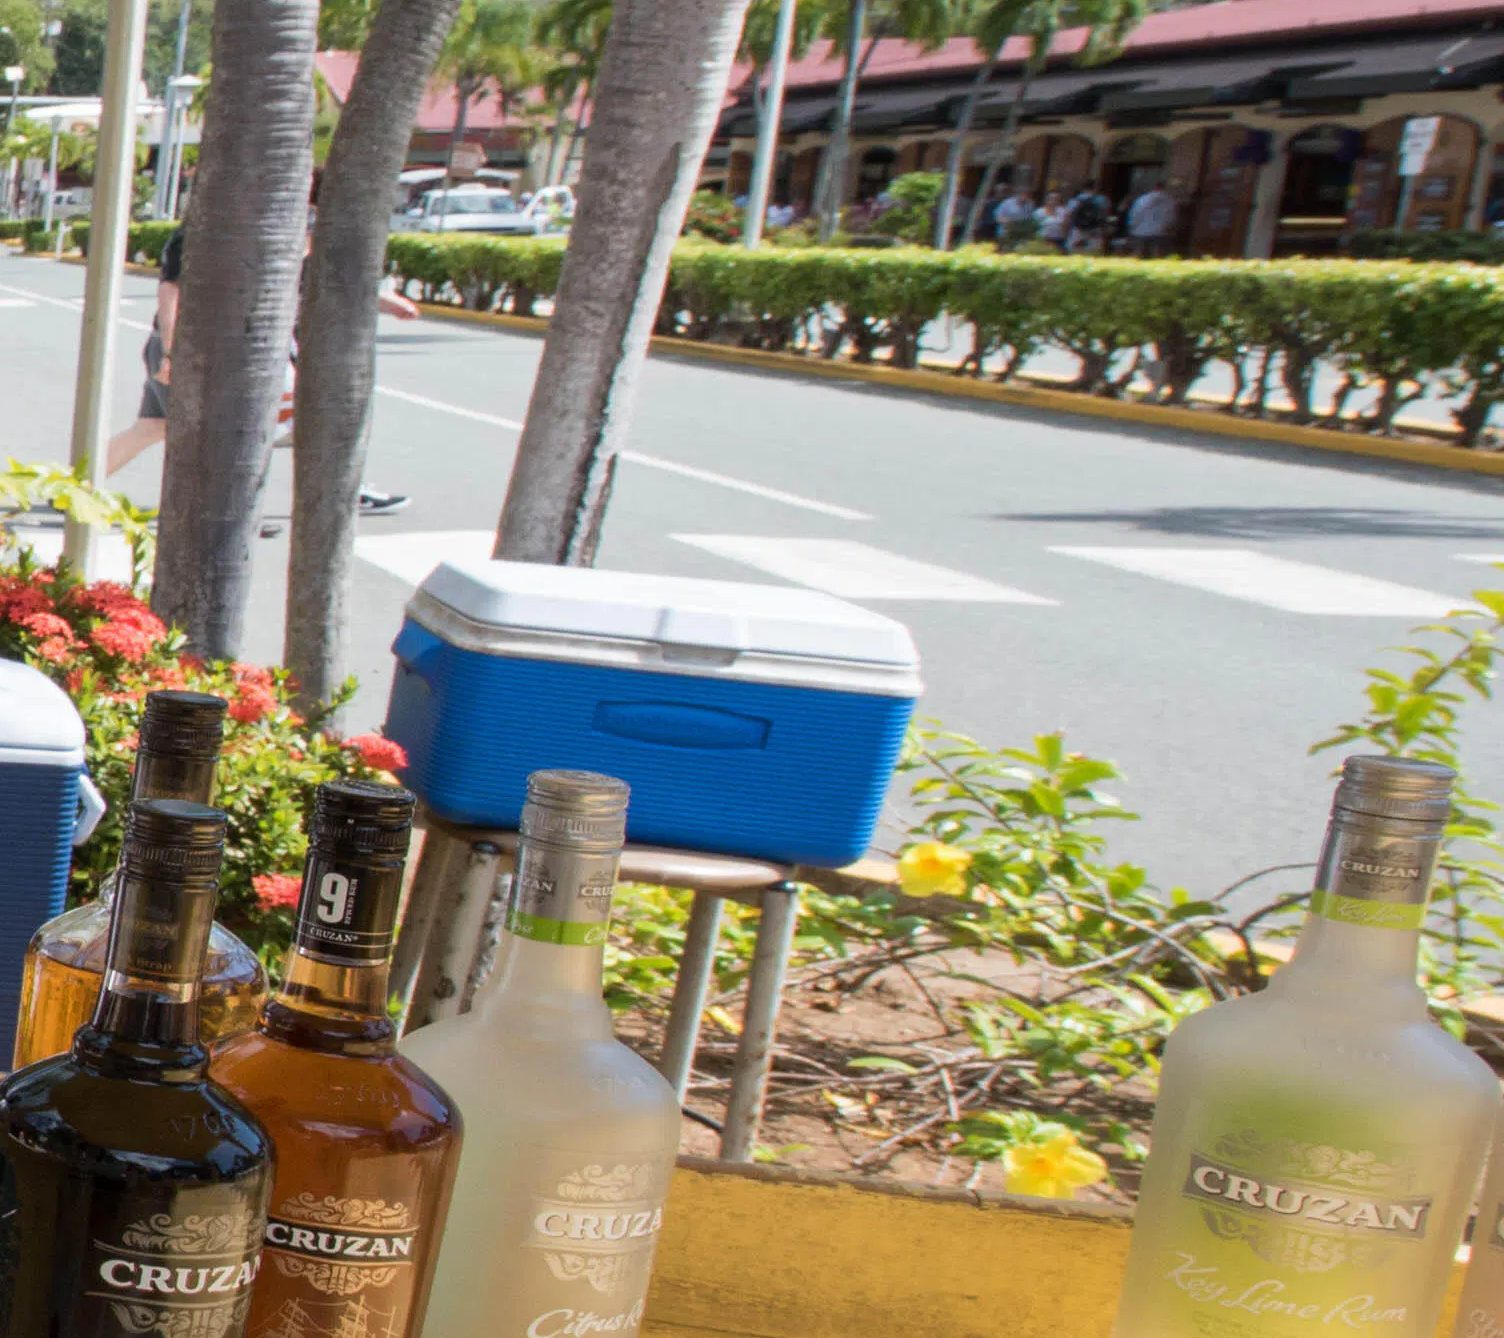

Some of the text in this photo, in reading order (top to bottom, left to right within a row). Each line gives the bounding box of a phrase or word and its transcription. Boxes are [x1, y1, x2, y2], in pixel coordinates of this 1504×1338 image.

[1340, 860, 1420, 878] CRUZAN
[316, 872, 349, 925] 9
[309, 926, 354, 943] CRUZAN
[1192, 1165, 1425, 1231] CRUZAN
[265, 1222, 413, 1258] CRUZAN
[533, 1205, 664, 1241] CRUZA
[1164, 1249, 1408, 1329] Key Lime Rum
